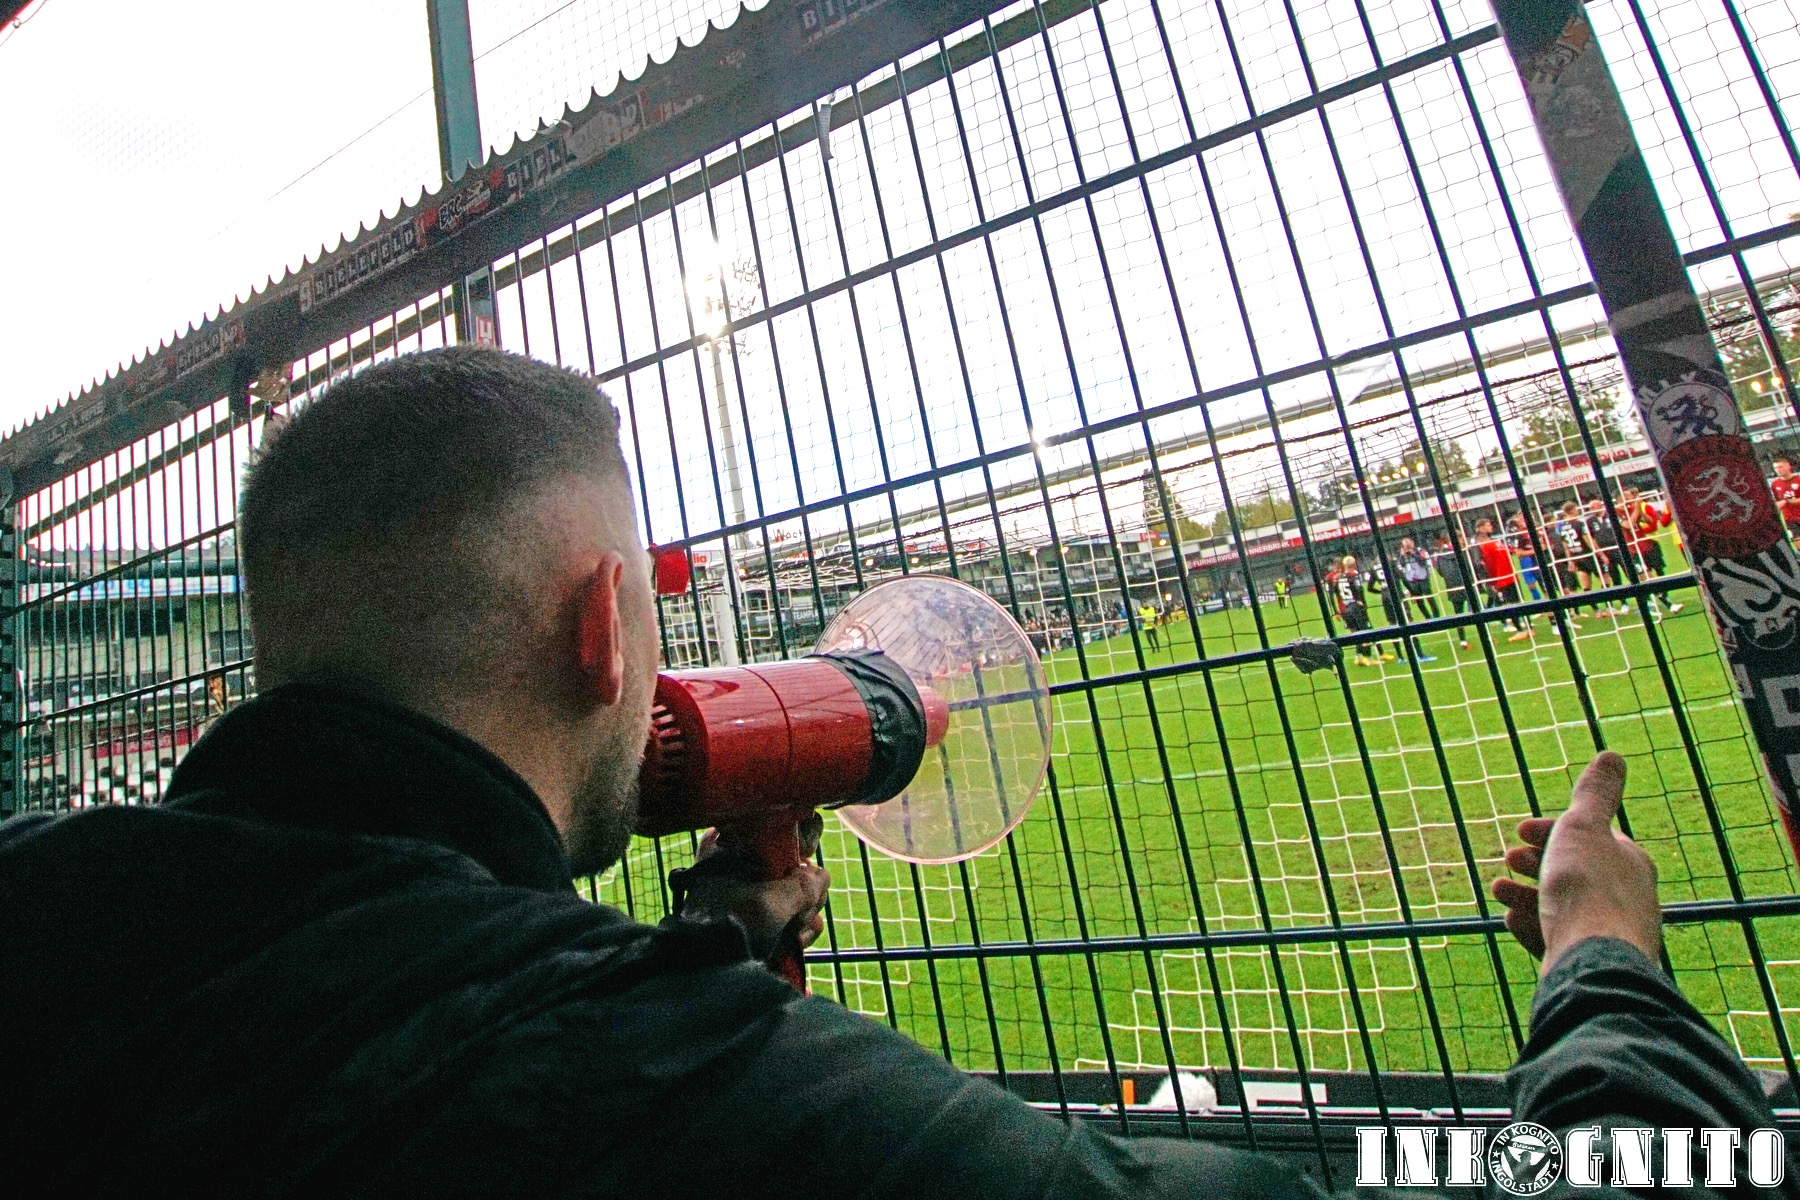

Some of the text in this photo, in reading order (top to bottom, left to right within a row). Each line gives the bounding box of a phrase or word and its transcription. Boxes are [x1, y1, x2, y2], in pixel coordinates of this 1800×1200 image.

[1431, 500, 1470, 515] BEHOFF
[1561, 528, 1581, 548] 32
[1192, 552, 1240, 567] FURNIERWER
